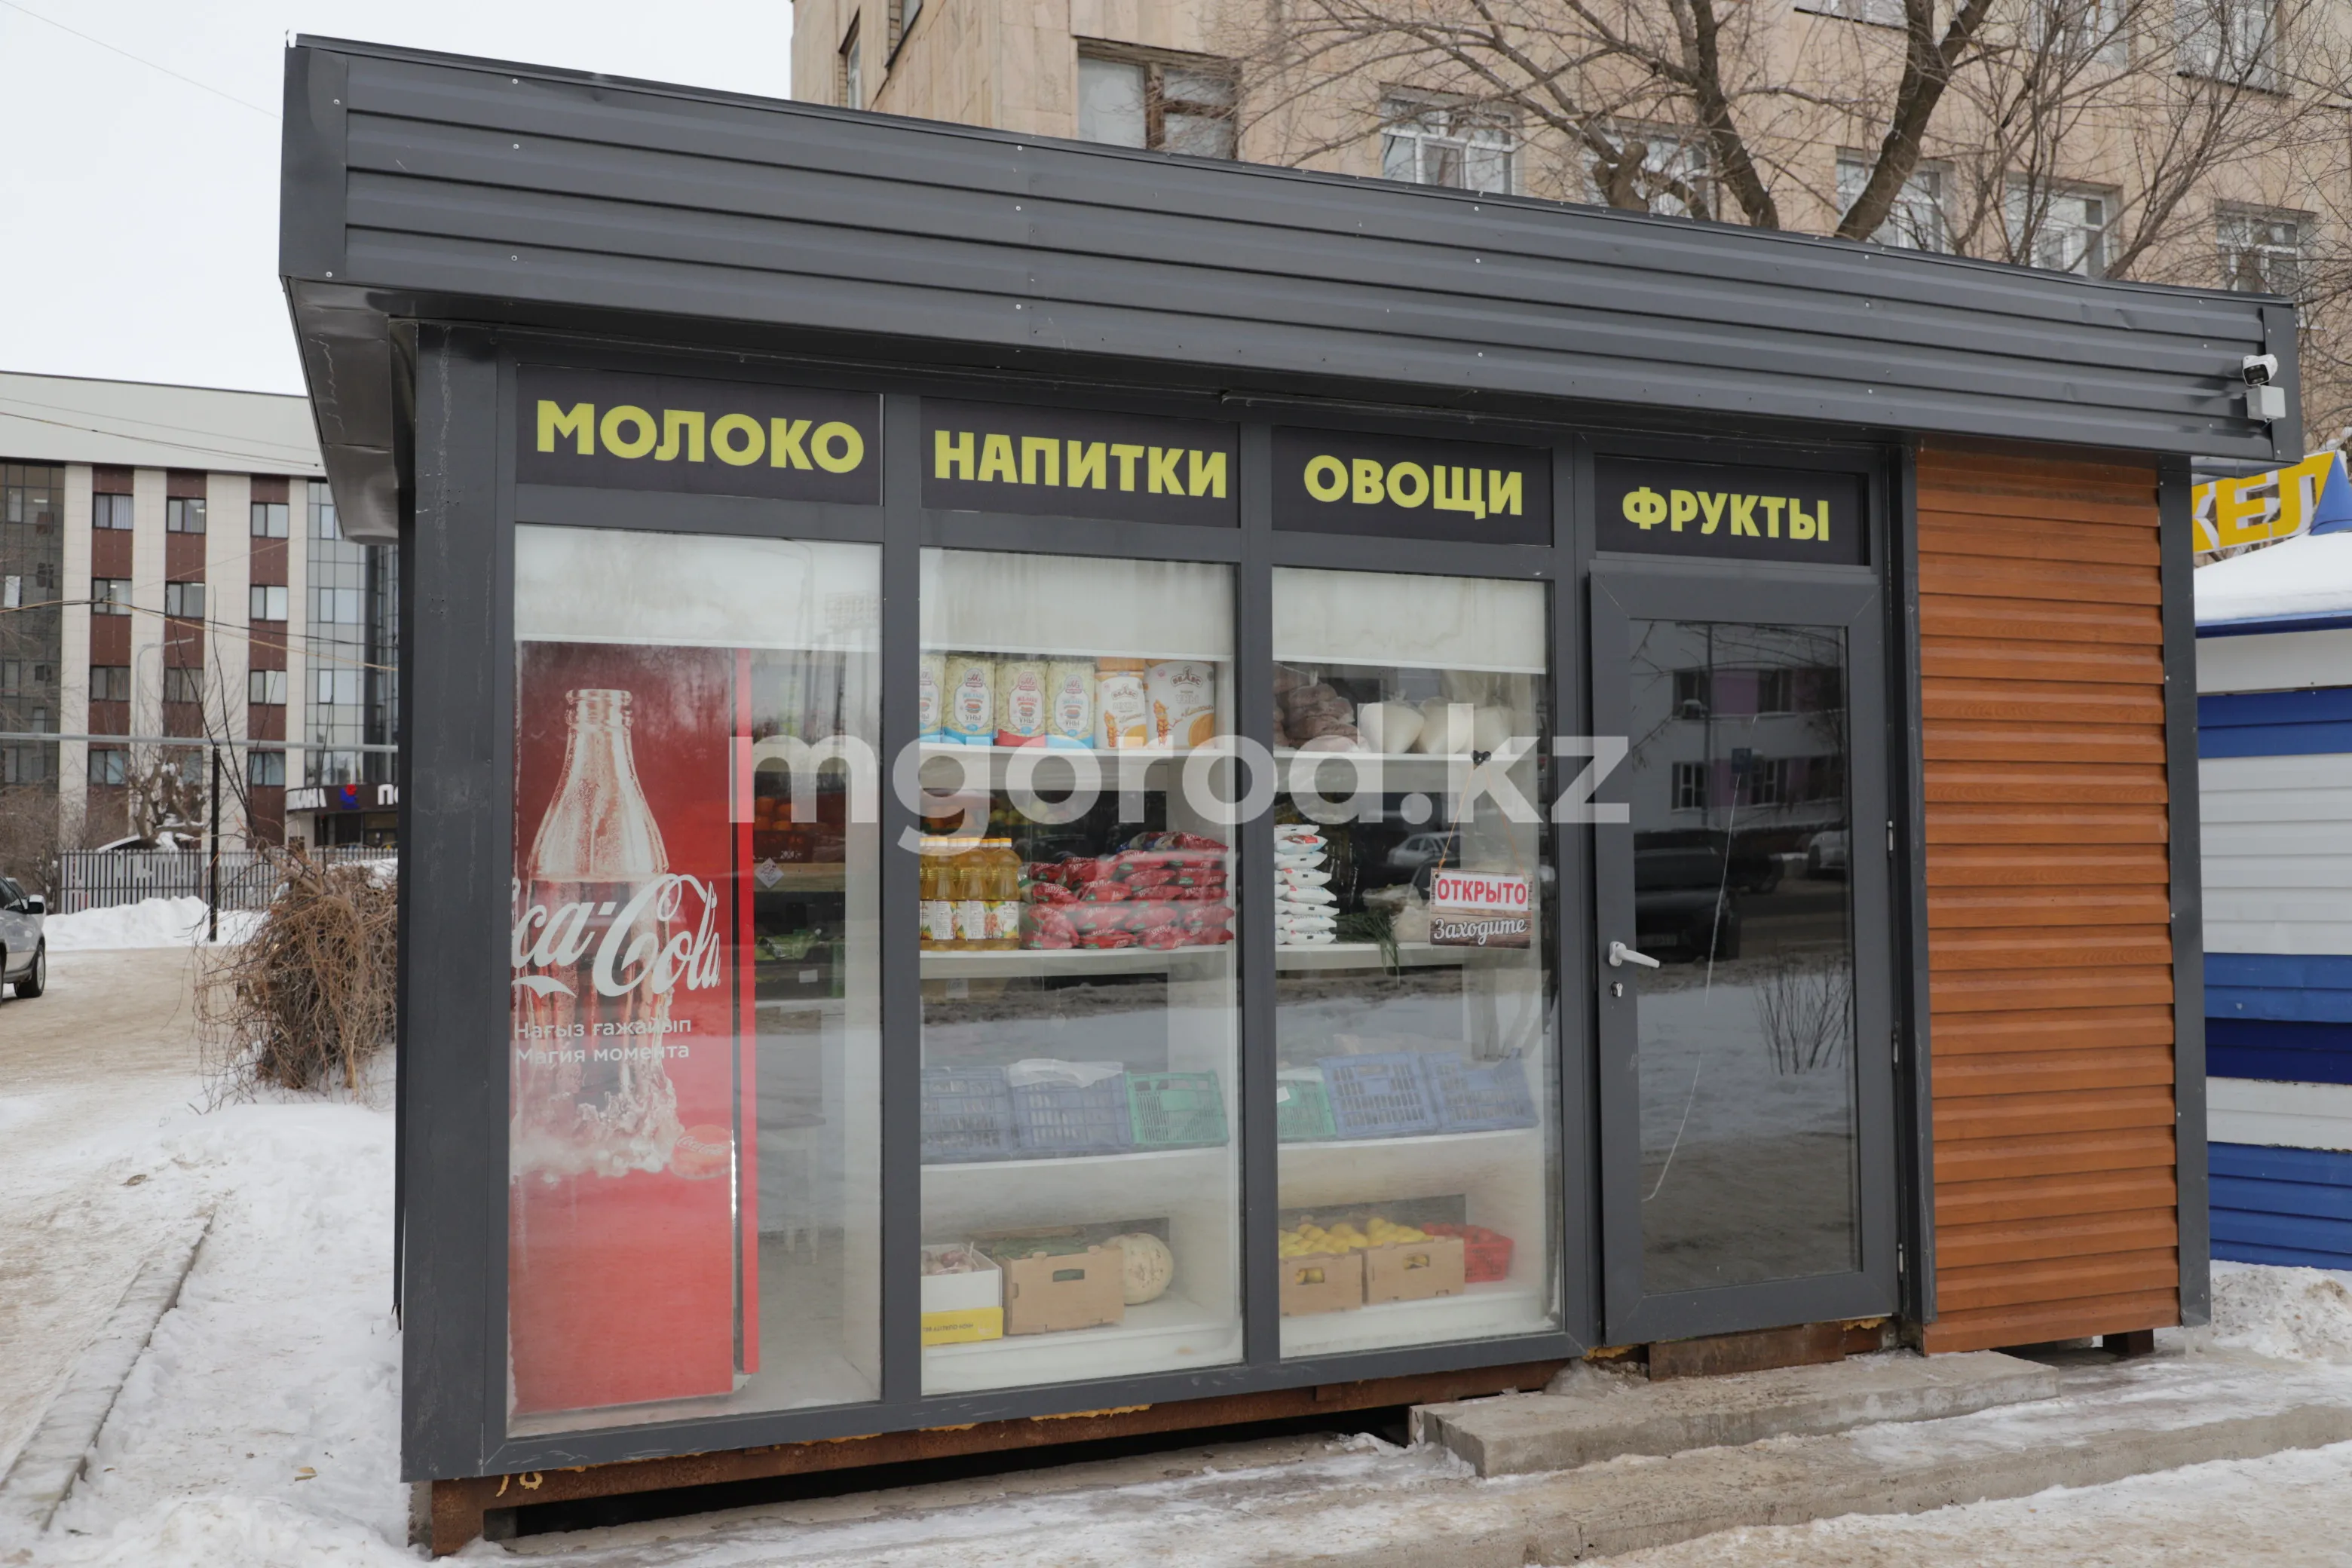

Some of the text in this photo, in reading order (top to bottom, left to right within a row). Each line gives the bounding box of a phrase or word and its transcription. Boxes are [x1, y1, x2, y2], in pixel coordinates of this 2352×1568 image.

[537, 400, 865, 474] МОЛОКО
[934, 429, 1227, 499] НАПИТКИ
[1303, 455, 1524, 520] ОВОЩИ
[1622, 486, 1830, 542] ФРУКТЫ
[1437, 878, 1527, 905] ОТКРЫТО
[511, 873, 721, 997] ca-Cola
[1433, 917, 1528, 946] Заходите
[514, 1016, 691, 1039] Нағыз ғажайып
[516, 1045, 690, 1064] Магия момента
